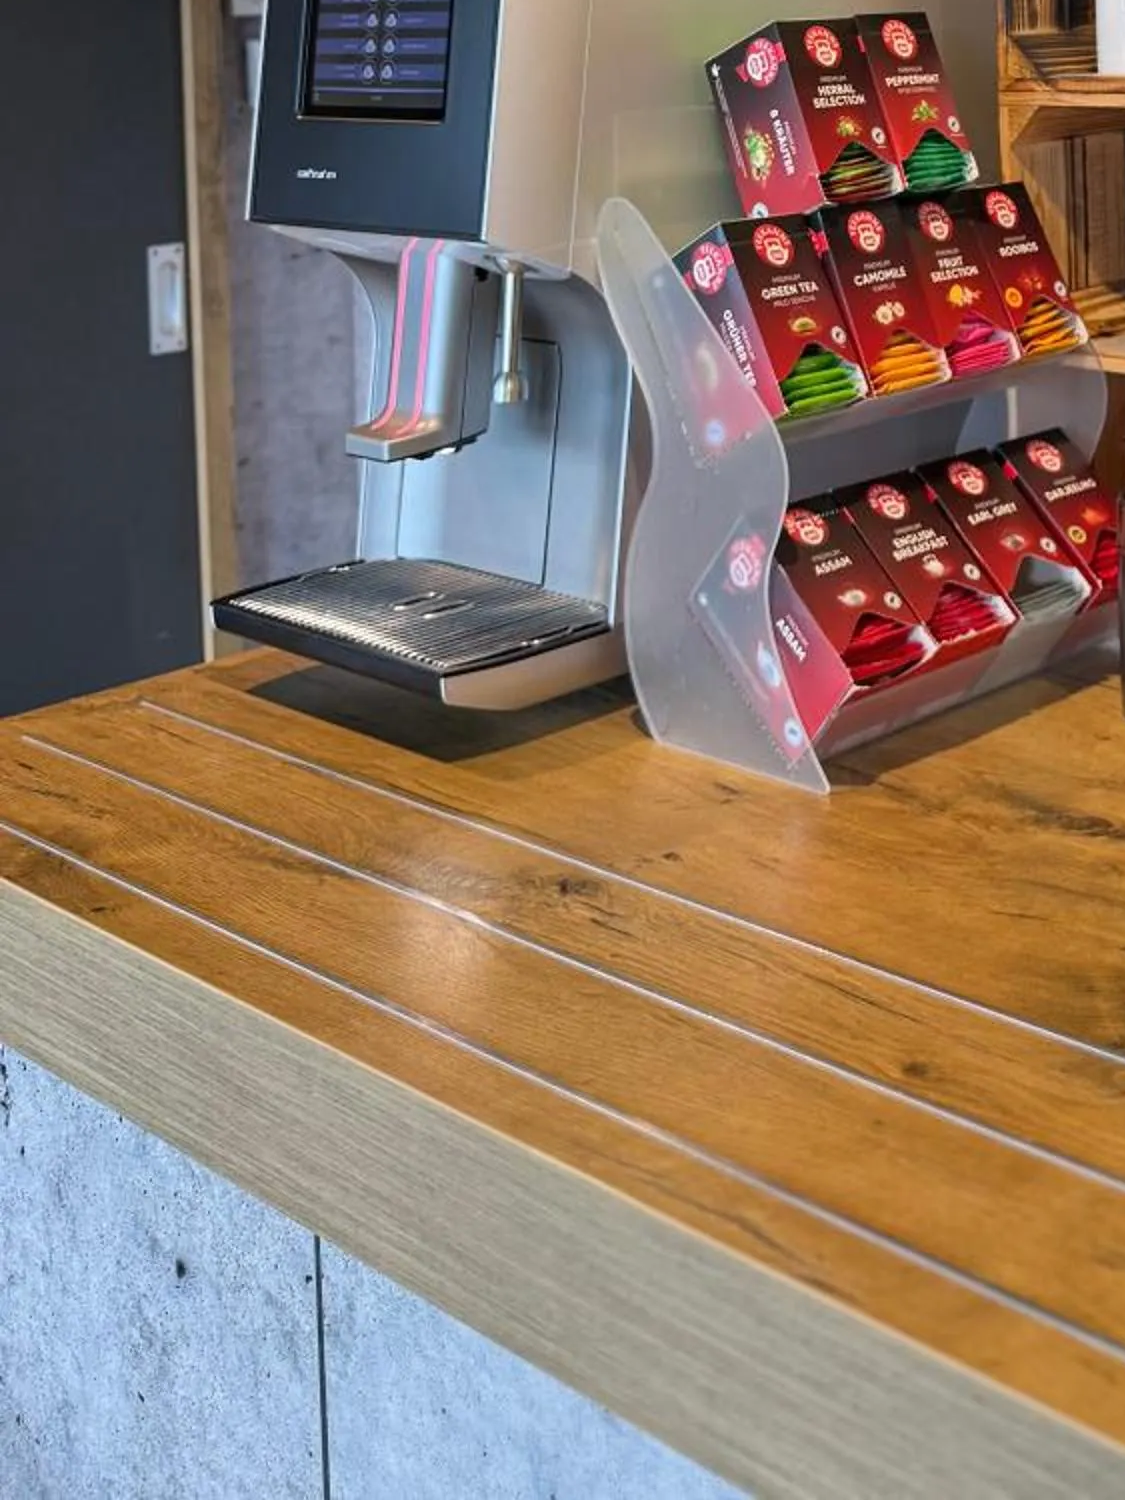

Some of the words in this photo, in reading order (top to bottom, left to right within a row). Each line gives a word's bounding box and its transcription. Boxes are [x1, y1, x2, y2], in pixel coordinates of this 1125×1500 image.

[817, 84, 856, 97] HERBAL
[885, 74, 940, 88] PEPPERMINT
[813, 94, 867, 109] SELECTION
[853, 266, 907, 286] CAMOMILE
[930, 265, 979, 283] SELECTION
[762, 284, 798, 300] GREEN
[799, 281, 819, 294] TEA
[723, 309, 747, 366] GRÜNER
[814, 555, 853, 576] ASSAM
[776, 618, 807, 662] ASSAM
